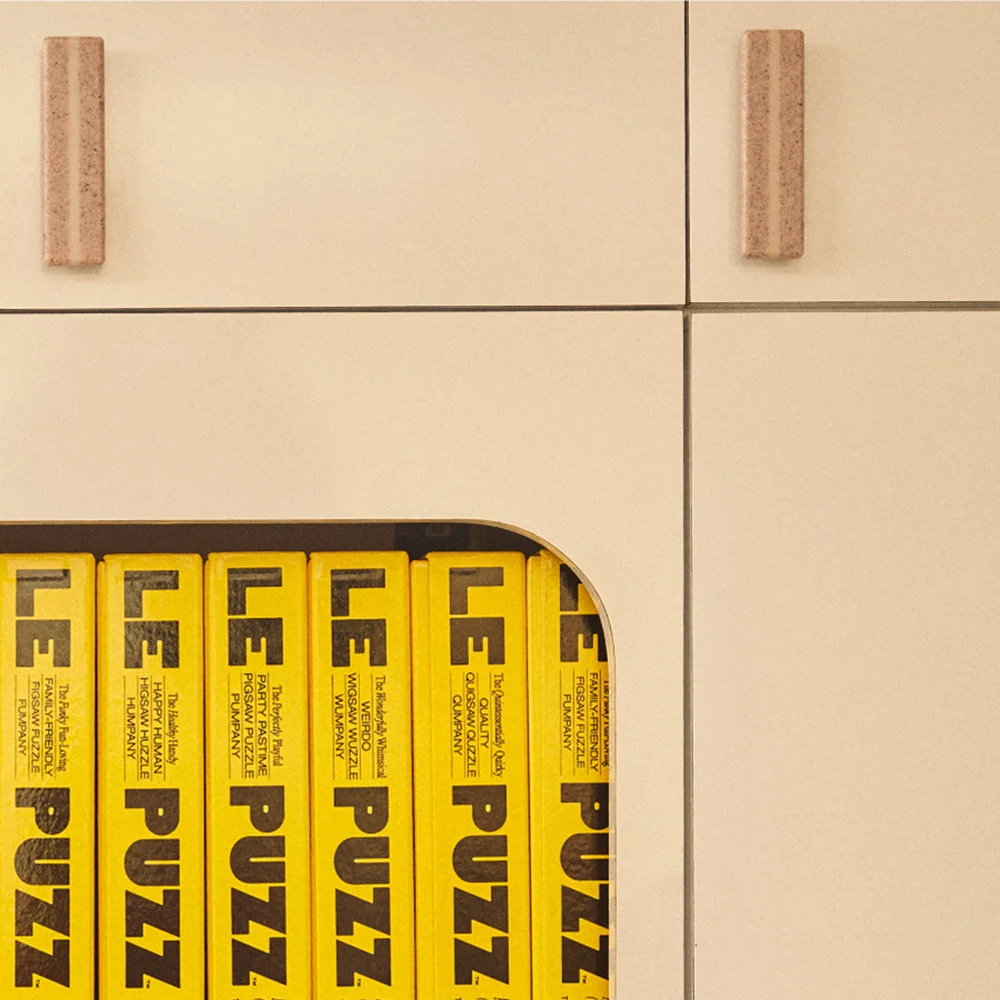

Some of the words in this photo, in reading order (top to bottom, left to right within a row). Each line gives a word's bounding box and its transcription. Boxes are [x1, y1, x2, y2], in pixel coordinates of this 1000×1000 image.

[16, 569, 70, 667] LE
[124, 570, 179, 668] LE
[227, 567, 283, 666] LE
[330, 568, 387, 667] LE
[449, 567, 505, 665] LE
[32, 682, 40, 726] FIGSAW
[59, 684, 69, 700] The
[140, 678, 149, 727] HIGSAW
[153, 682, 162, 724] HAPPY
[168, 693, 178, 708] The
[244, 673, 253, 724] PIGSAW
[258, 674, 268, 717] PARTY
[272, 685, 282, 701] The
[348, 673, 357, 725] WIGSAW
[466, 672, 475, 728] QUIGSAW
[494, 673, 504, 688] The
[576, 676, 585, 721] FIGSAW
[18, 699, 26, 755] FUMPANY
[45, 678, 53, 776] FAMILY-FRIENDLY
[57, 701, 69, 725] Funky
[127, 698, 136, 759] HUMPANY
[166, 710, 178, 738] Healthy
[231, 693, 240, 758] PUMPANY
[270, 702, 282, 736] Perfectly
[335, 694, 344, 759] WUMPANY
[361, 701, 371, 751] WEIRDO
[453, 695, 462, 755] QUMPANY
[480, 698, 489, 748] QUALITY
[492, 690, 505, 748] Quintessentially
[563, 694, 571, 751] FUMPANY
[590, 673, 598, 772] FAMILY-FRIENDLY
[31, 729, 40, 773] FUZZLE
[56, 727, 69, 772] Fun-Loving
[140, 730, 149, 779] HUZZLE
[153, 727, 162, 774] HUMAN
[166, 738, 178, 765] Handy
[244, 727, 254, 778] PUZZLE
[258, 721, 267, 776] PASTIME
[270, 739, 283, 766] Playful
[348, 728, 358, 780] WUZZLE
[467, 730, 476, 777] QUZZLE
[493, 750, 505, 777] Quirky
[576, 724, 585, 767] FUZZLE
[15, 788, 70, 988] PUZZ
[124, 788, 180, 988] PUZZ
[230, 786, 287, 986] PUZZ
[334, 786, 391, 987] PUZZ
[452, 785, 509, 985] PUZZ
[560, 782, 609, 983] PUZZ
